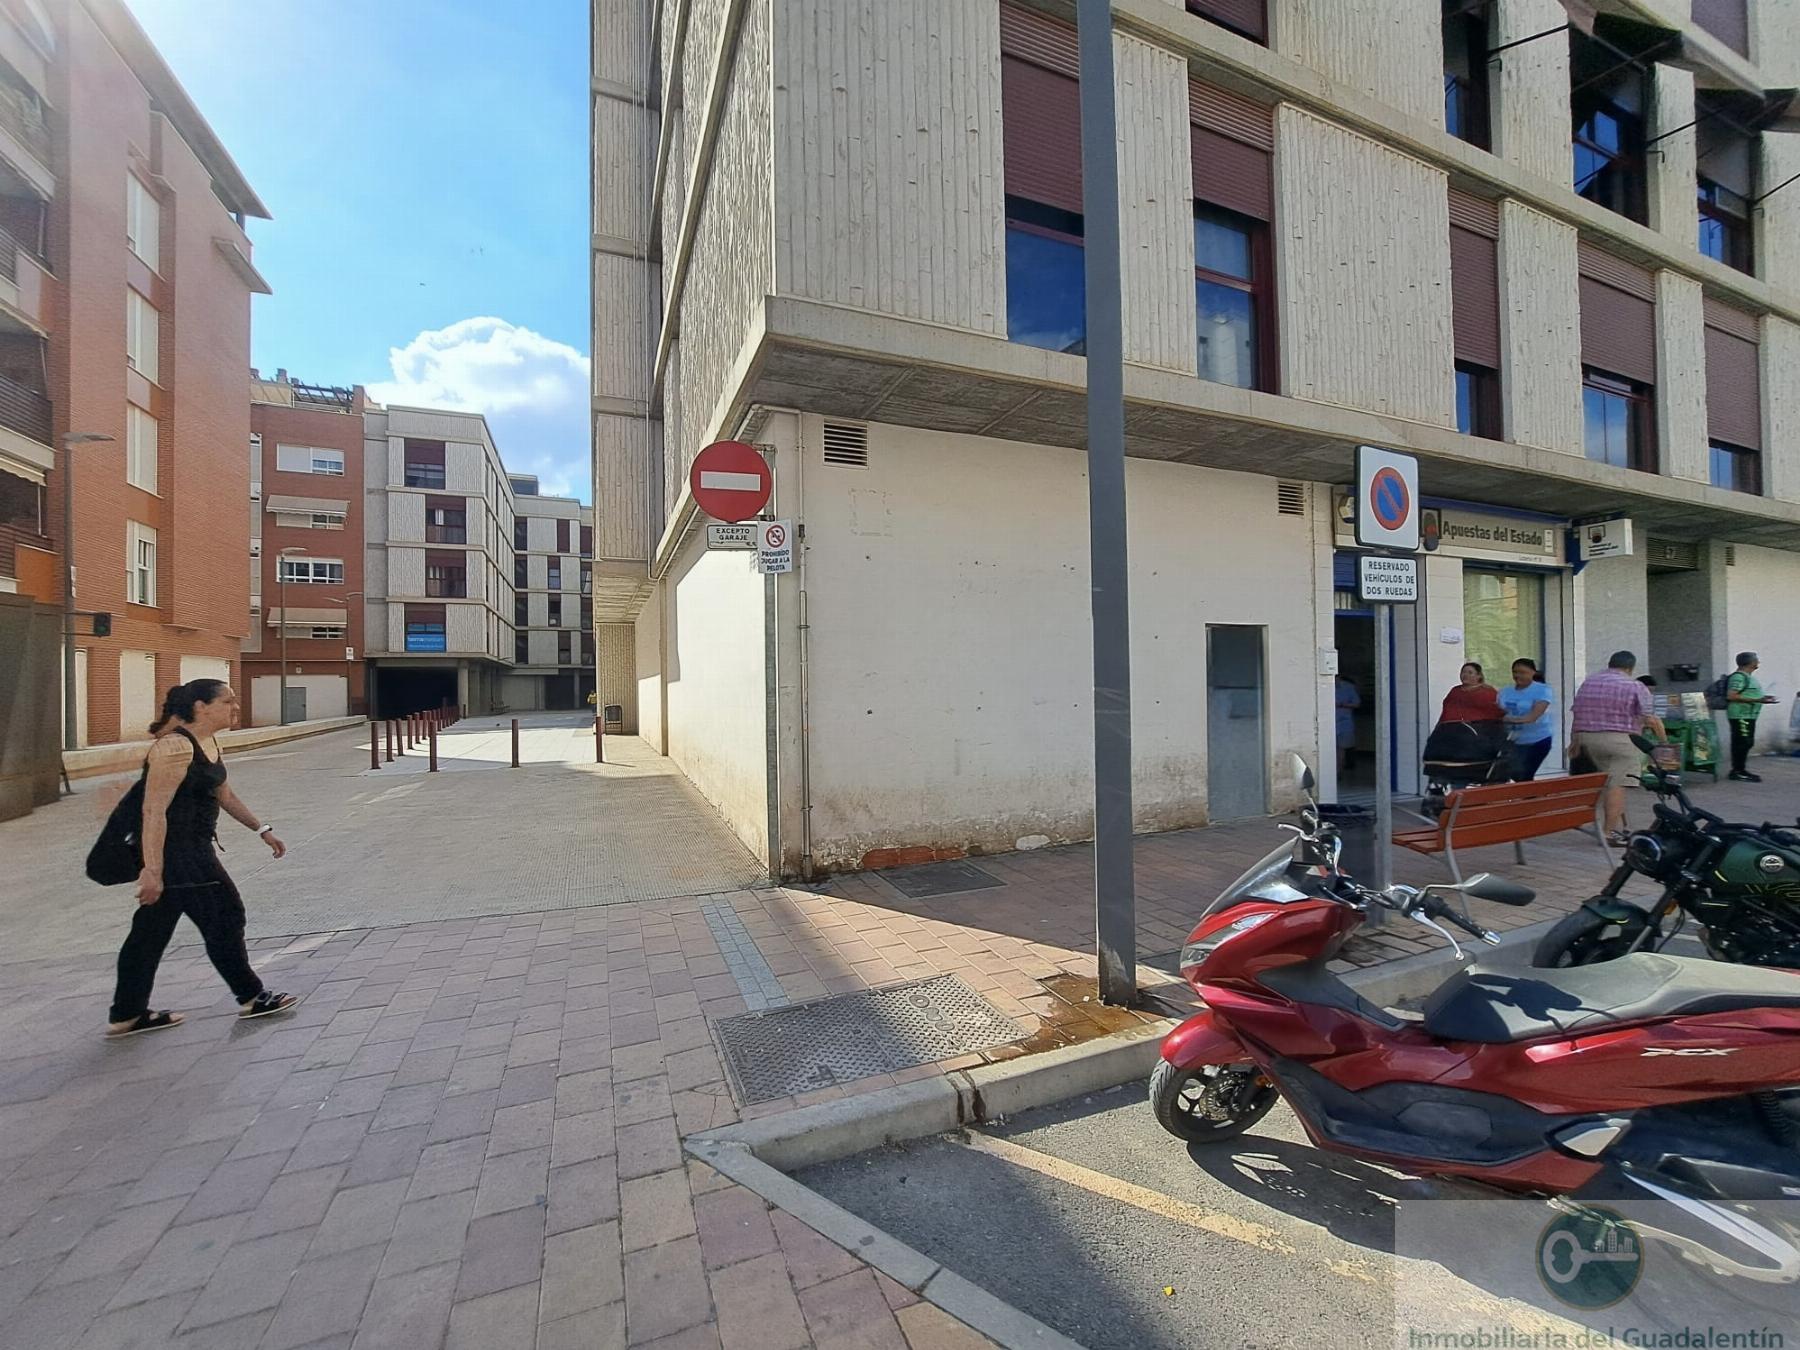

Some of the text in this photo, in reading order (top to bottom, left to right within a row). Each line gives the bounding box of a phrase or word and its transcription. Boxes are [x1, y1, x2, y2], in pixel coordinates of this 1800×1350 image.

[1442, 520, 1491, 540] Apuestas
[1493, 525, 1508, 542] del
[1510, 528, 1543, 546] Estado
[761, 549, 790, 557] PROHIBIDO
[761, 557, 778, 565] JUGAR
[1368, 560, 1410, 571] RESERVADO
[766, 564, 786, 572] PELOTA
[1405, 575, 1415, 584] DE
[1366, 586, 1413, 596] DOS RUEDAS
